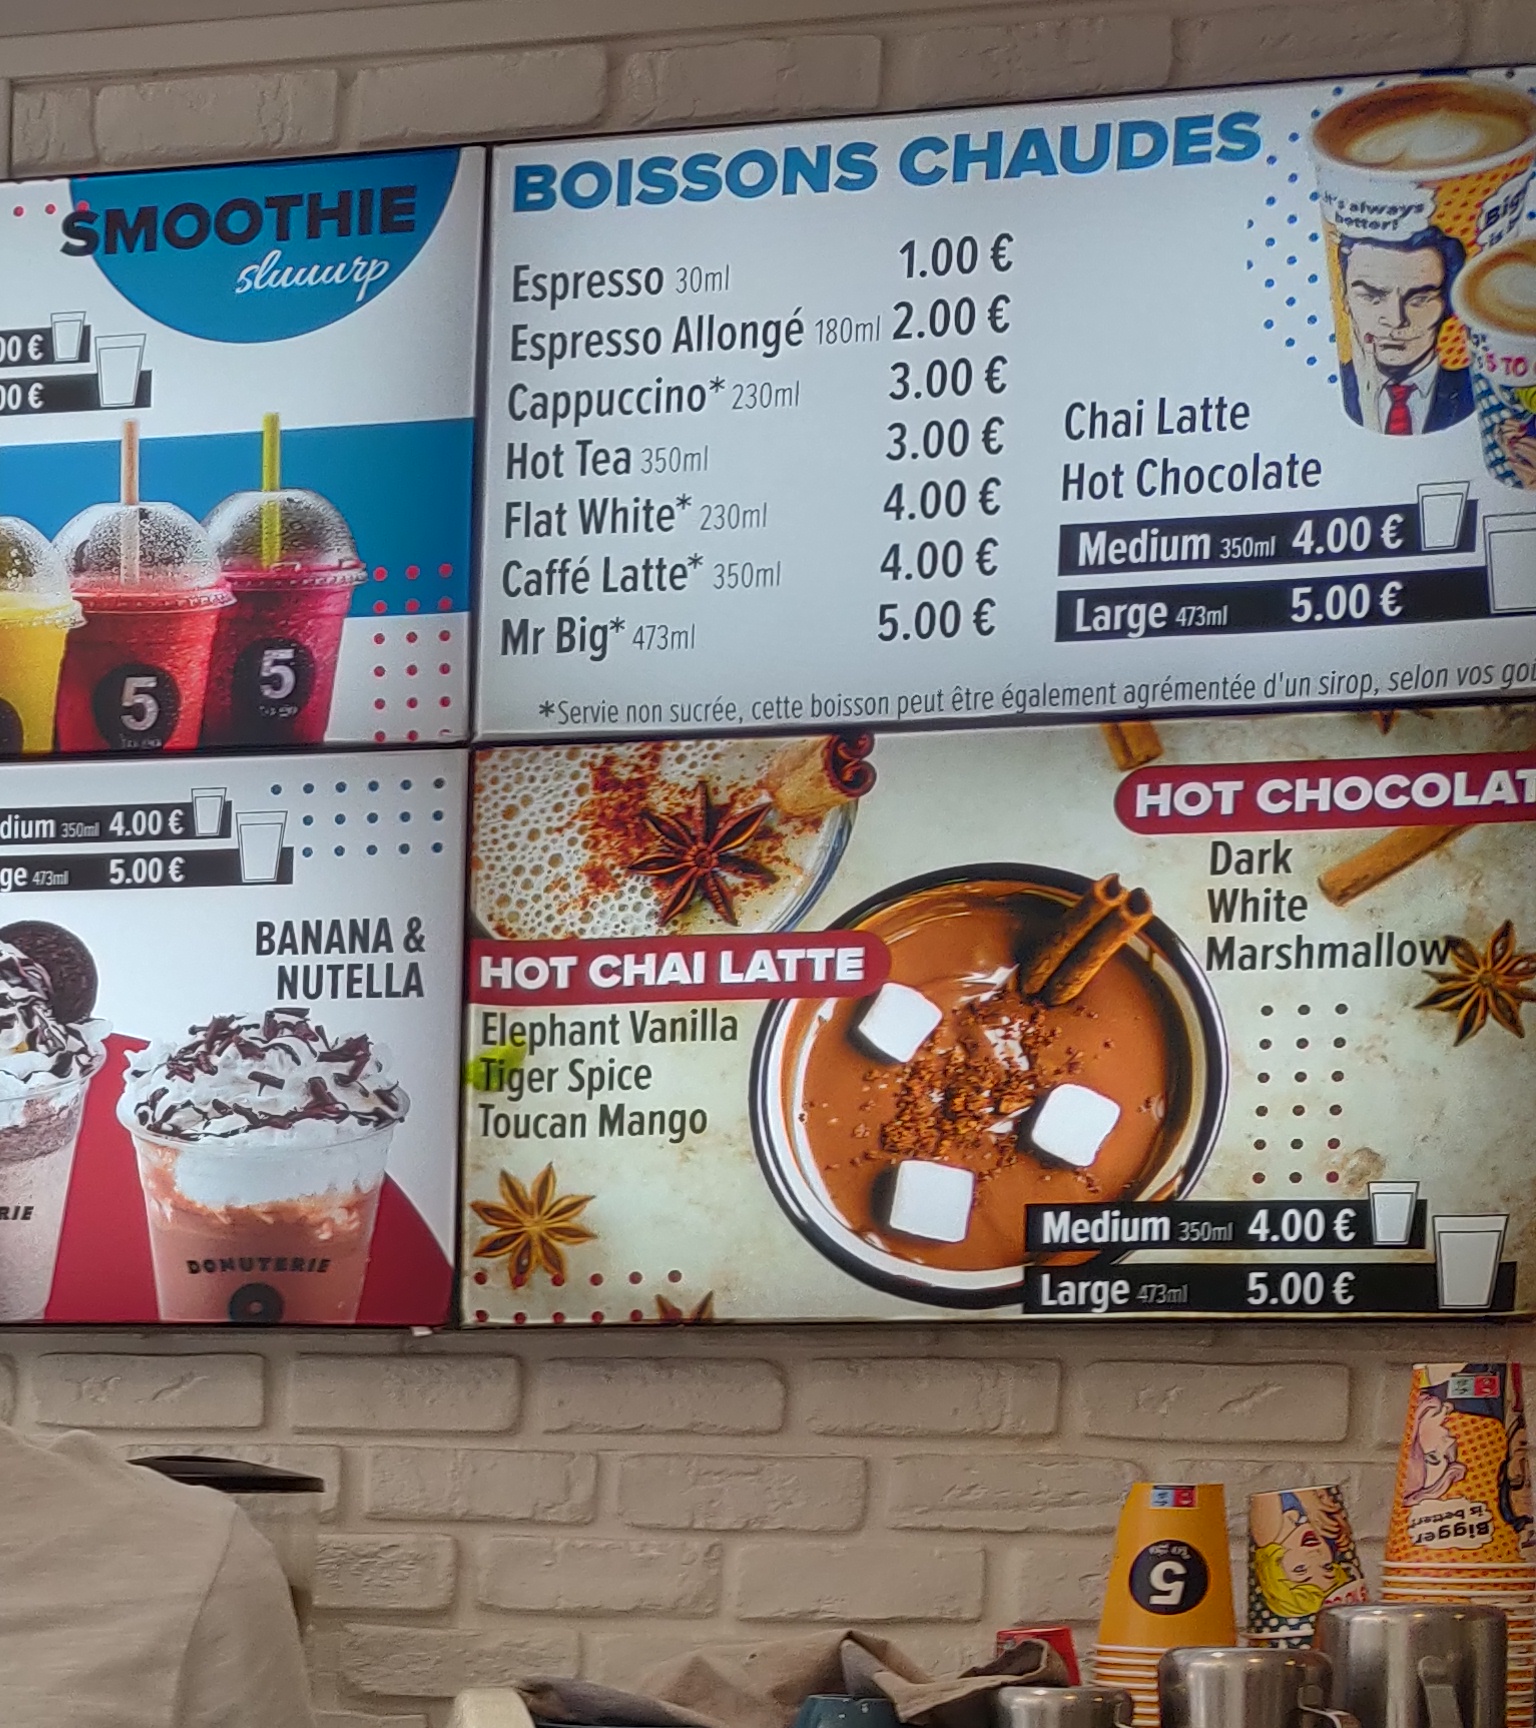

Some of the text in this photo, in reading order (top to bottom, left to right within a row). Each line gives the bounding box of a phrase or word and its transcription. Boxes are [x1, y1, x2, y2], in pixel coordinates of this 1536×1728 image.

[513, 111, 1261, 214] BOISSONS CHAUDES
[61, 185, 416, 257] SMOOTHIE
[511, 233, 1015, 310] Espresso 30ml 1.00 €
[28, 334, 43, 362] €
[509, 294, 1011, 372] Espresso Allongé 180ml 2.00 €
[28, 382, 44, 411] €
[731, 378, 800, 412] 230ml
[888, 359, 972, 400] 3.00
[984, 355, 1009, 395] €
[1063, 394, 1250, 442] Chai Latte
[505, 438, 710, 481] Hot Tea 350ml
[1060, 451, 1322, 502] Hot Chocolate
[503, 499, 569, 539] Flat
[699, 500, 768, 533] 230ml
[501, 555, 591, 599] Caffé
[712, 557, 781, 591] 350ml
[499, 618, 548, 656] Mr
[632, 620, 696, 652] 473ml
[259, 648, 296, 700] 5
[626, 702, 663, 724] non
[670, 697, 743, 725] sucrée,
[751, 694, 803, 720] cette
[810, 691, 890, 720] boisson
[896, 690, 944, 720] peut
[951, 685, 994, 711] être
[1001, 681, 1116, 712] également
[1123, 675, 1256, 709] agrémentée
[1263, 671, 1311, 698] d'un
[1317, 669, 1380, 700] sirop,
[1387, 665, 1448, 692] selon
[1456, 662, 1493, 687] vos
[1135, 780, 1234, 819] HOT
[1209, 841, 1292, 876] Dark
[1208, 887, 1308, 924] White
[255, 917, 427, 958] BANANA &
[1205, 932, 1452, 972] Marshmallow
[276, 963, 425, 1001] NUTELLA
[479, 947, 864, 989] HOT CHAI LATTE
[480, 1008, 739, 1051] Elephant Vanilla
[480, 1055, 653, 1097] Tiger Spice
[478, 1103, 709, 1144] Toucan Mango
[186, 1258, 332, 1275] DONUTERIE
[1415, 1523, 1490, 1545] Bigger
[1150, 1561, 1187, 1605] 5
